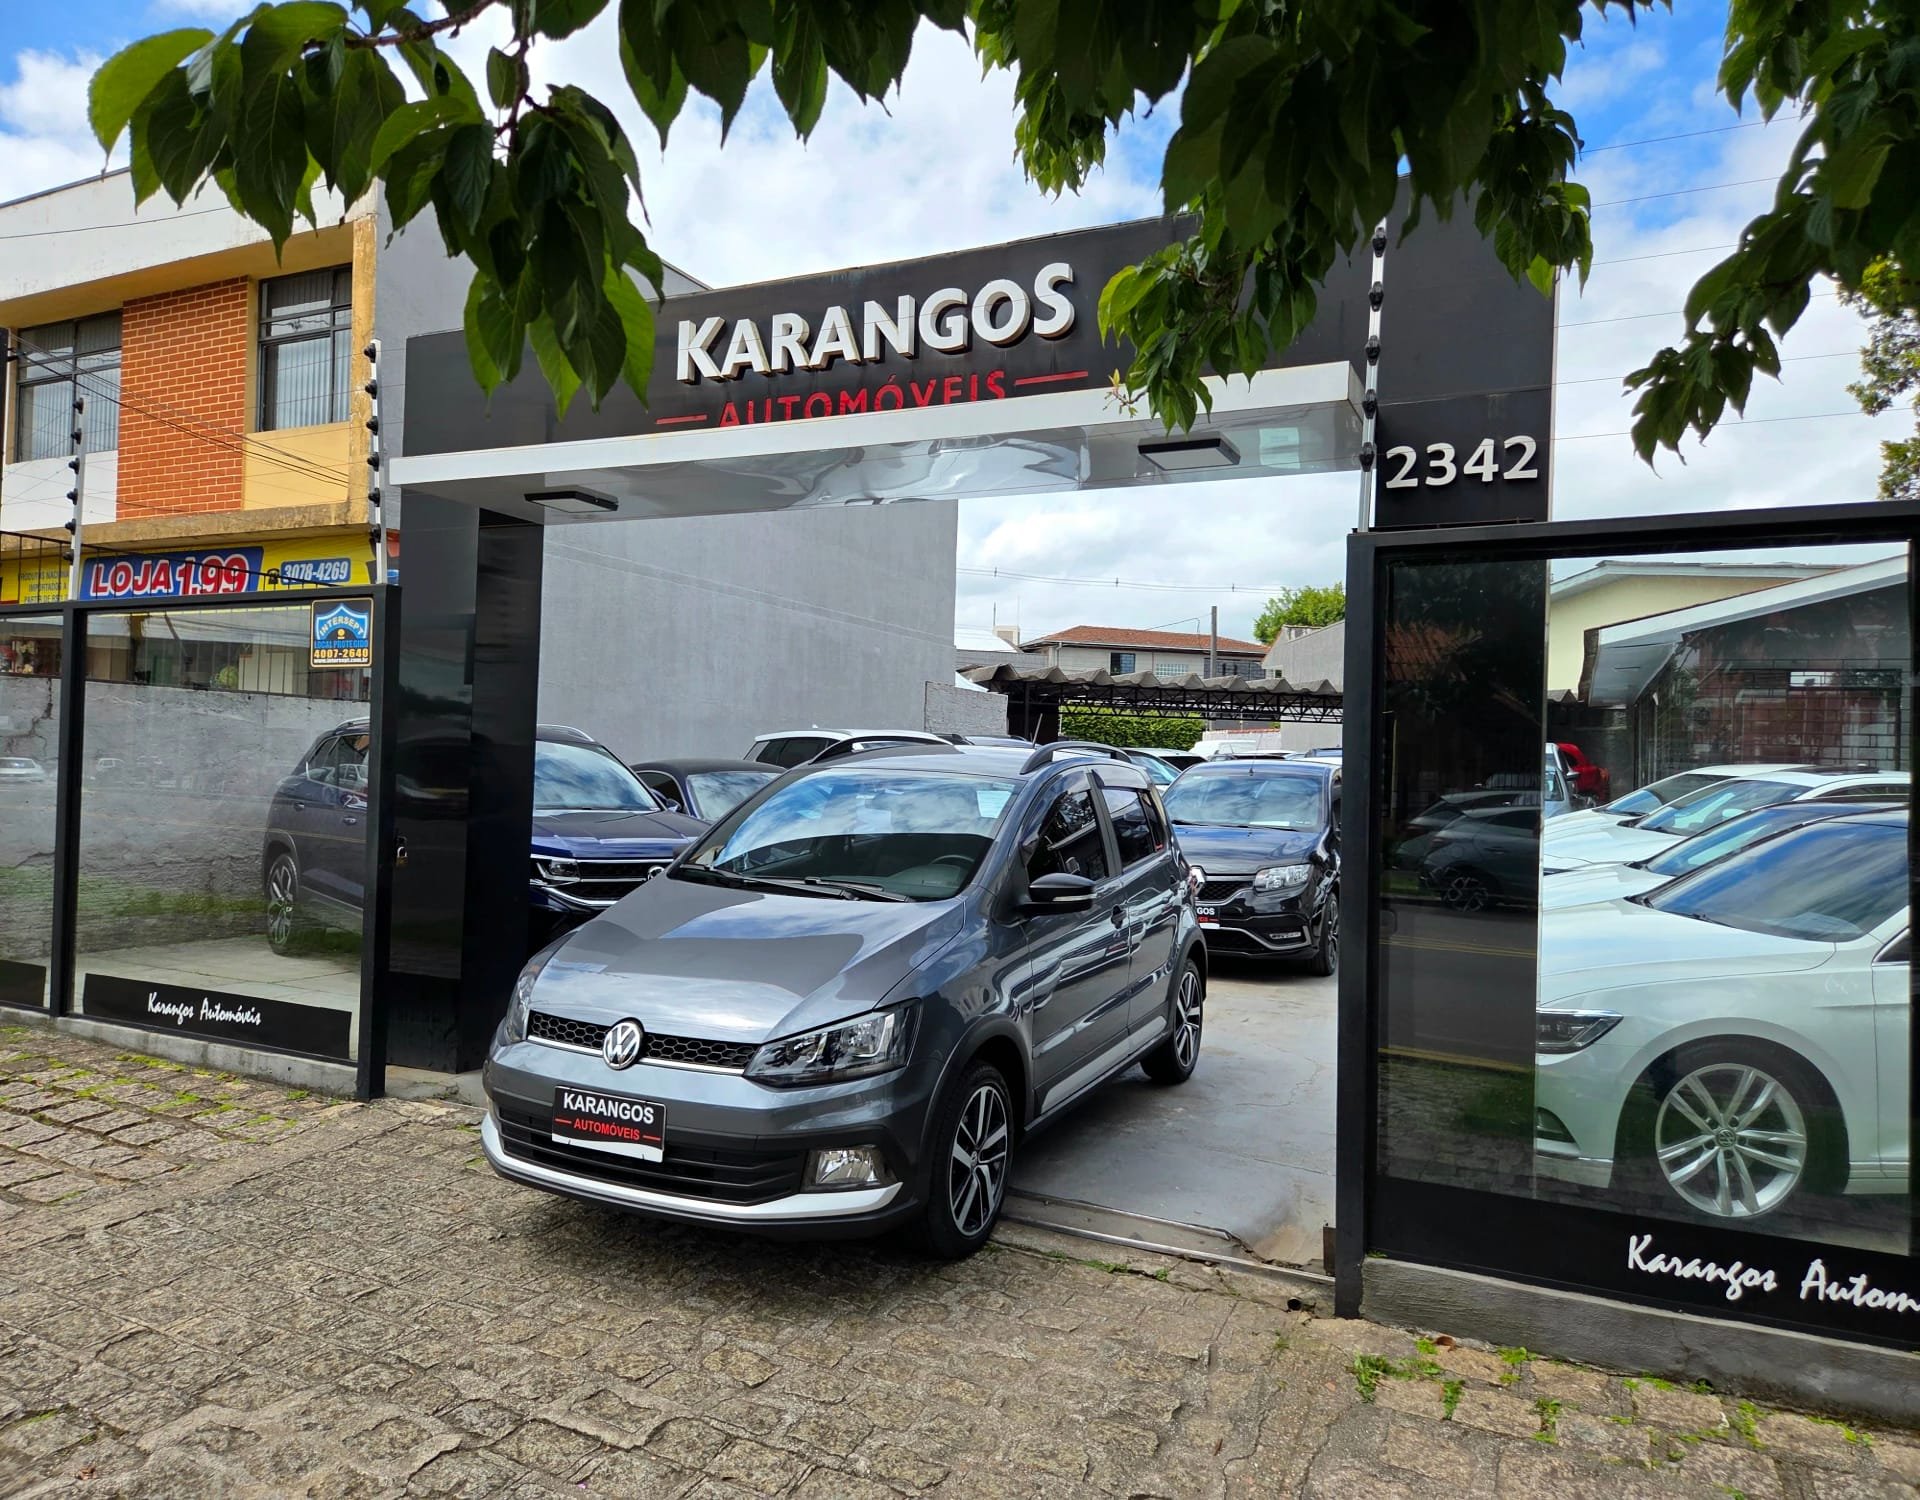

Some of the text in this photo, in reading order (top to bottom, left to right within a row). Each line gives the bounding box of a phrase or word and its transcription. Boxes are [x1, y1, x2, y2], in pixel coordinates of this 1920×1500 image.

[676, 262, 1076, 384] KARANGOS
[718, 370, 1006, 428] AUTOMÓVEIS
[1385, 435, 1539, 489] 2342
[90, 554, 250, 597] LOJA 1.99
[284, 562, 348, 585] 3078-4269
[320, 616, 364, 637] INTERSEPT
[147, 992, 261, 1025] Karangos Automóveis
[563, 1092, 655, 1124] KARANGOS
[573, 1118, 641, 1140] AUTOMÓVEIS
[1627, 1233, 1778, 1301] Karangos
